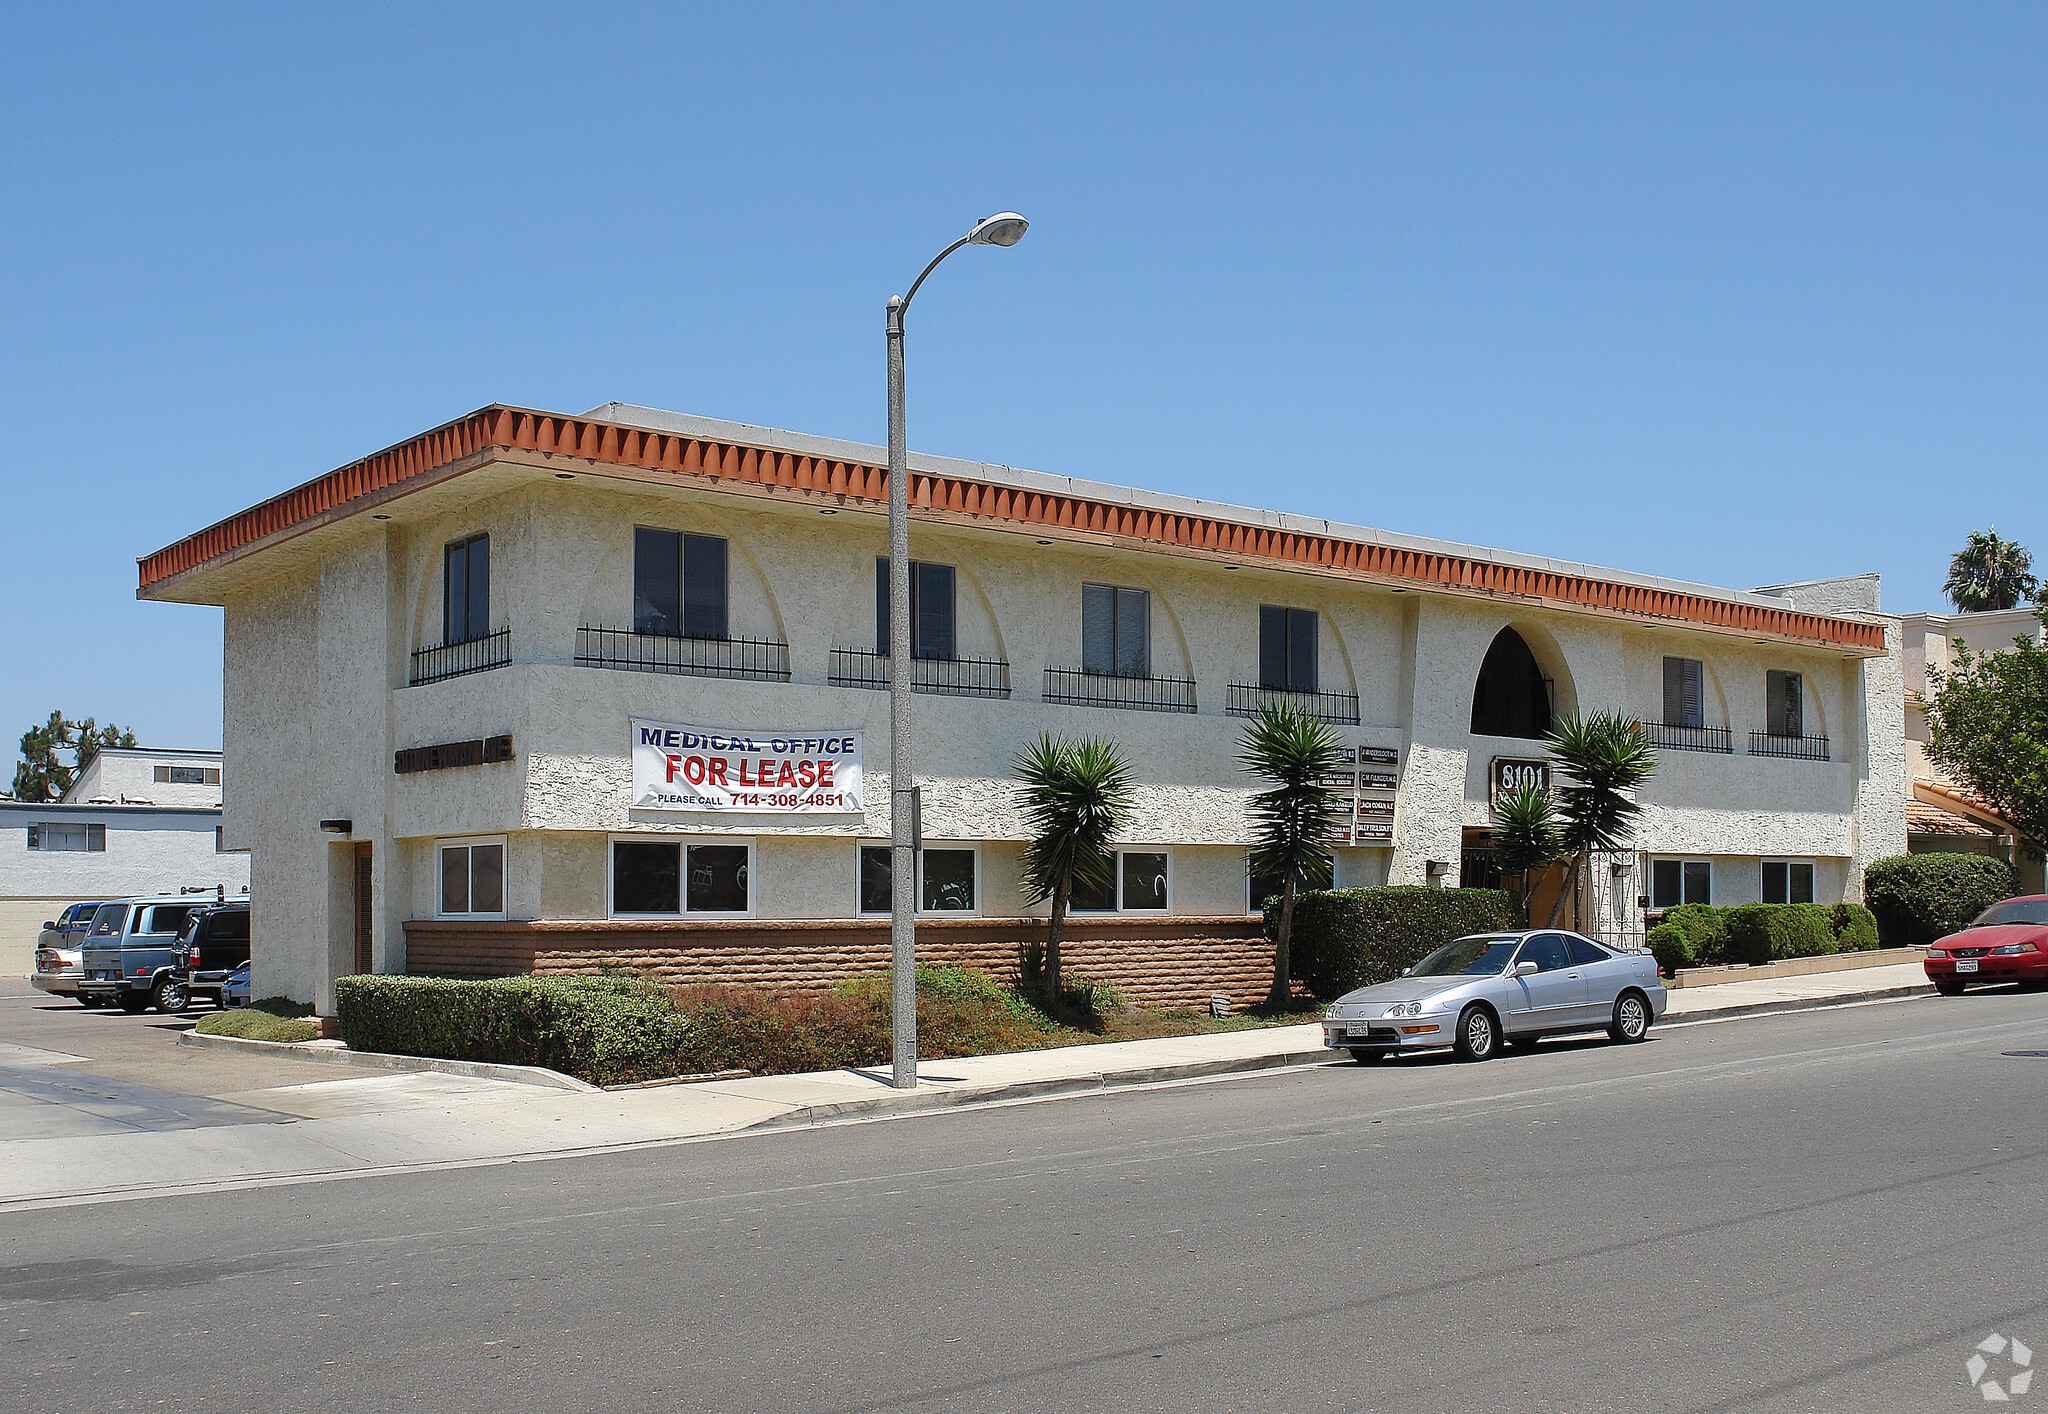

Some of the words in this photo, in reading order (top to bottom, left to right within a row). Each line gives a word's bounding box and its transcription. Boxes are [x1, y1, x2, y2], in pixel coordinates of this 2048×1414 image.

[640, 727, 761, 752] MEDICAL
[770, 737, 855, 754] OFFICE
[665, 754, 729, 786] FOR
[739, 758, 834, 788] LEASE
[1502, 764, 1542, 791] 8101
[657, 794, 696, 805] PLEASE
[697, 795, 723, 806] CALL
[730, 792, 844, 807] 714-308-4851
